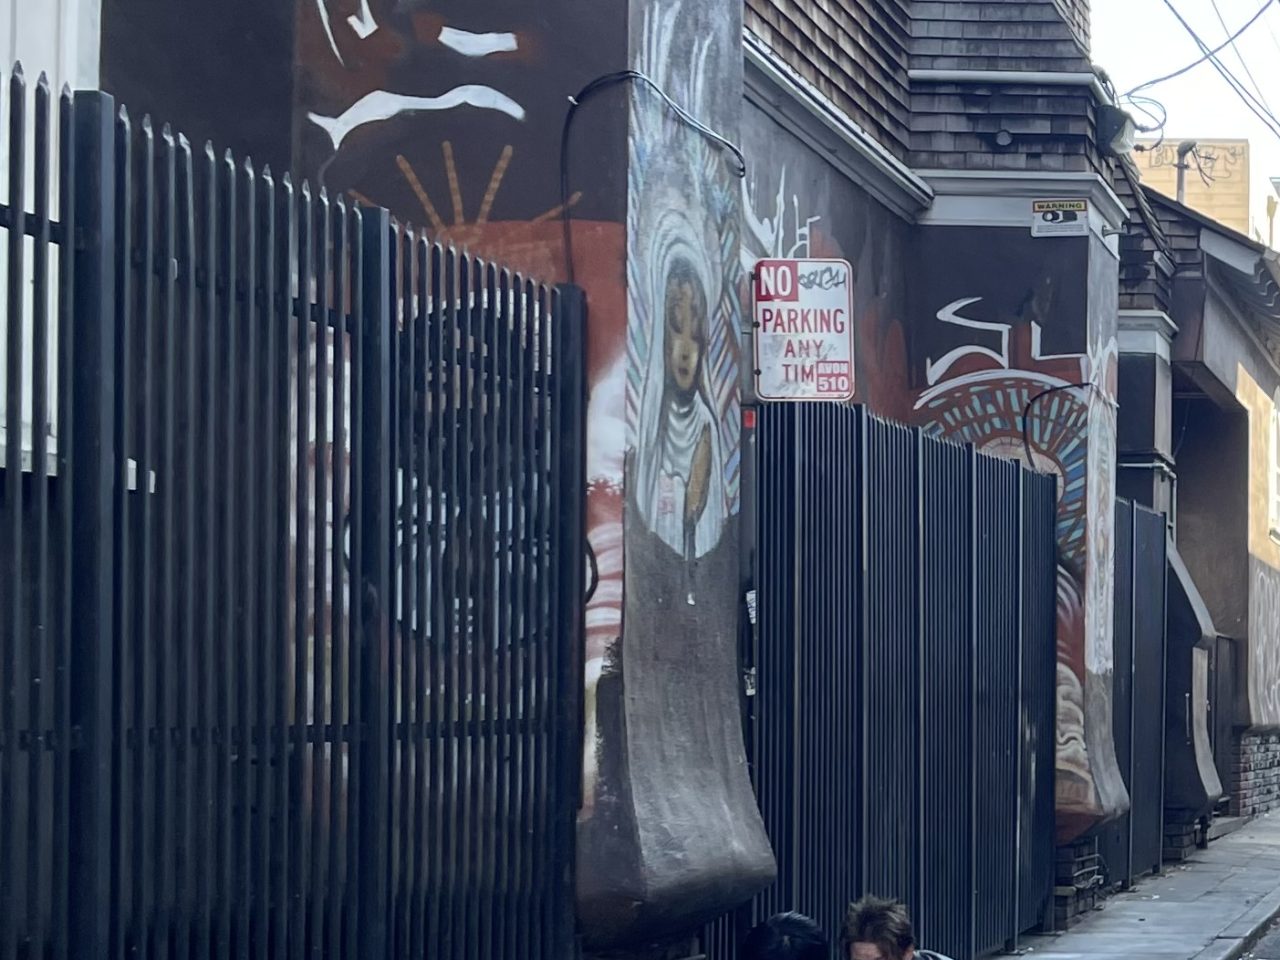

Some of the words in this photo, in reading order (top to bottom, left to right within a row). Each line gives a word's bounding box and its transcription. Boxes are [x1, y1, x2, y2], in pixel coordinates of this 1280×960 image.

[760, 266, 792, 296] NO
[762, 309, 845, 334] PARKING
[784, 339, 824, 358] ANY
[782, 364, 815, 383] TIM
[818, 378, 848, 391] 510
